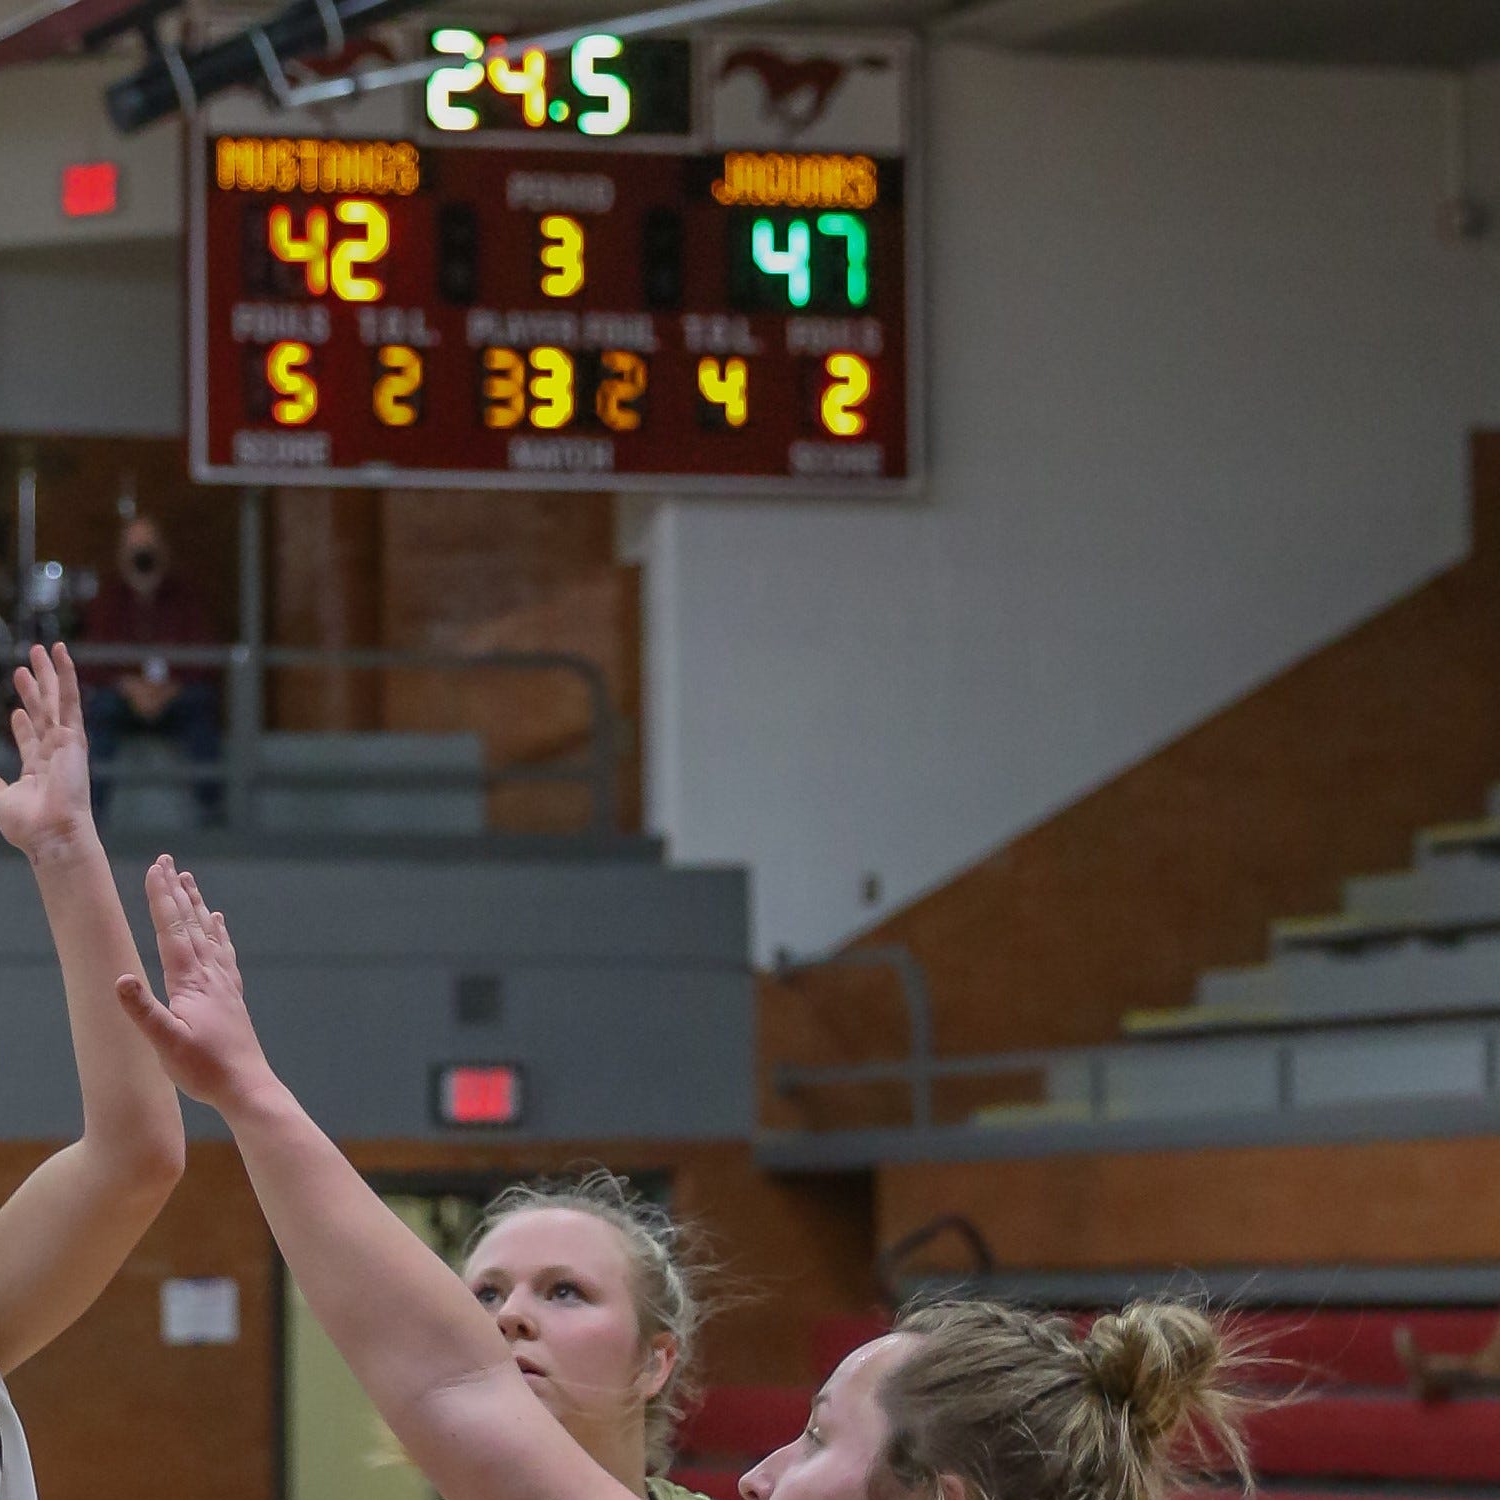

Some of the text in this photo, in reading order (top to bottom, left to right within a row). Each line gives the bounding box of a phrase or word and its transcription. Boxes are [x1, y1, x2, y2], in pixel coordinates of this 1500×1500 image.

[426, 28, 631, 135] 24.5
[269, 200, 390, 301] 42
[540, 215, 584, 297] 3
[752, 212, 868, 307] 47
[266, 340, 318, 425] 5
[372, 345, 424, 427] 2
[483, 346, 575, 429] 33
[595, 350, 648, 432] 2
[698, 356, 748, 429] 4
[819, 352, 871, 437] 2
